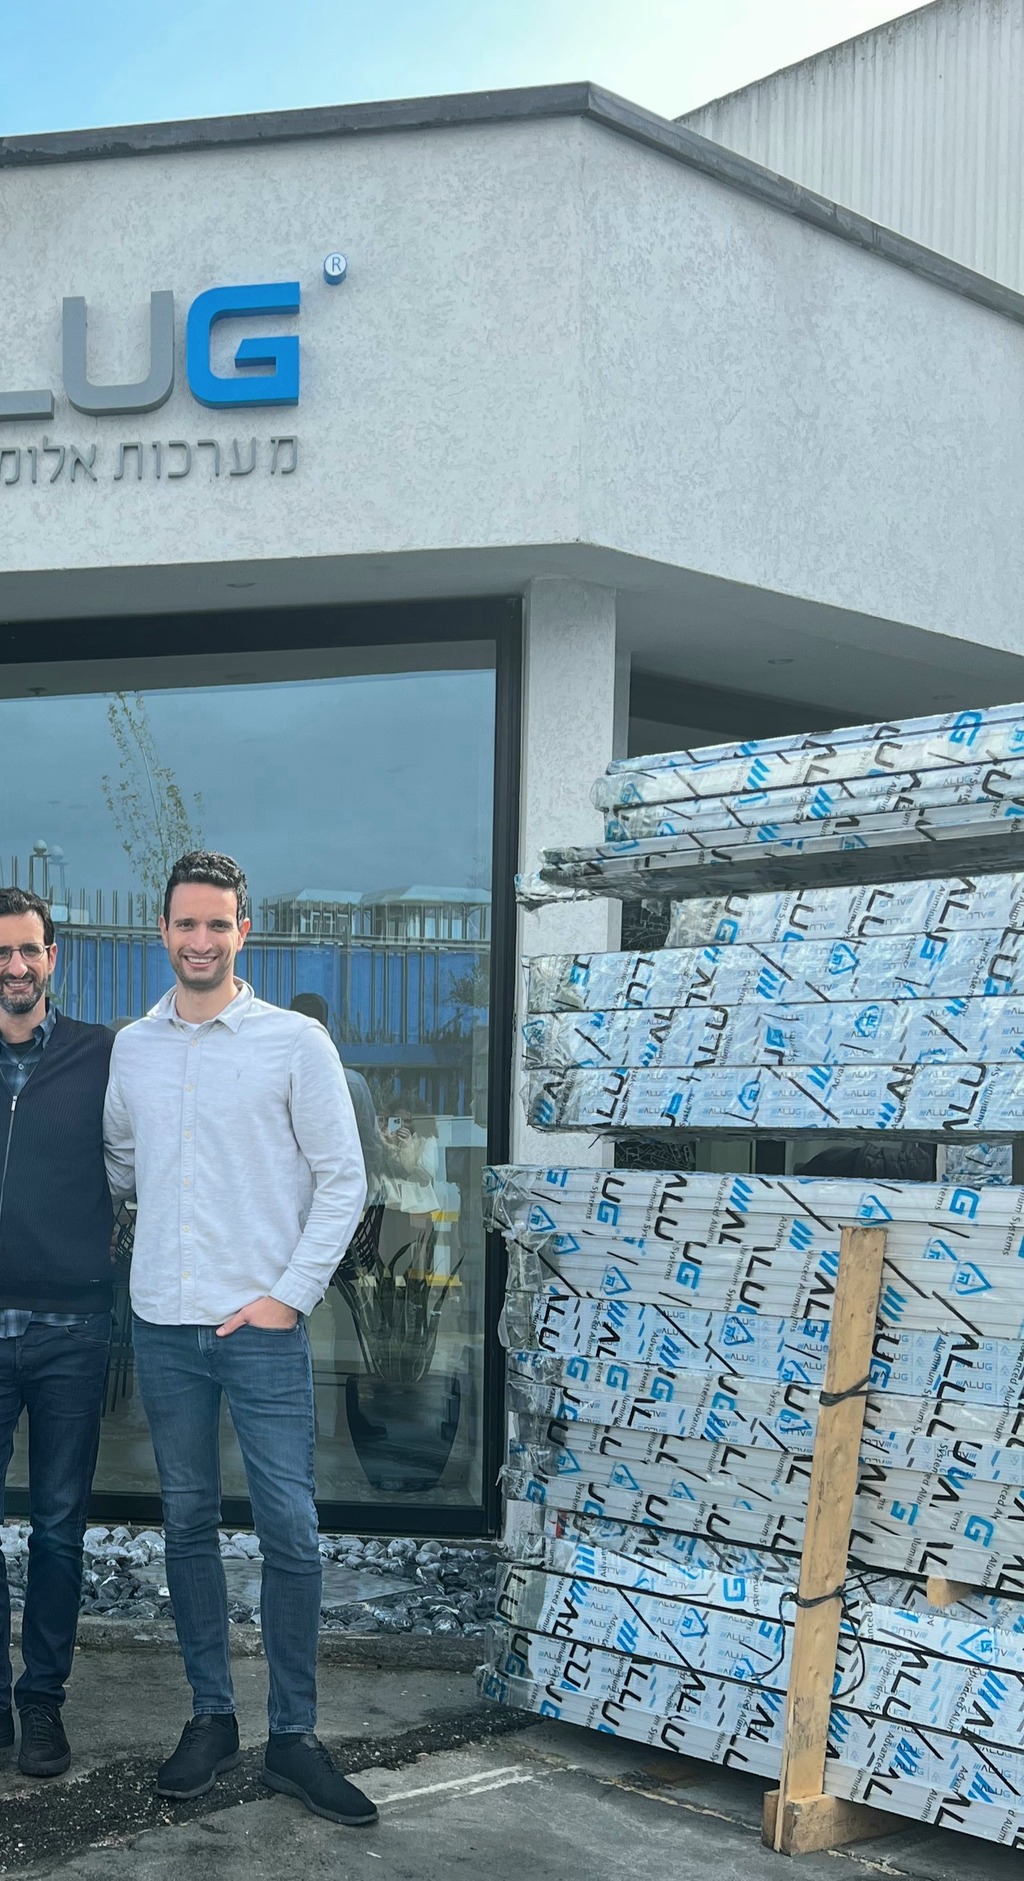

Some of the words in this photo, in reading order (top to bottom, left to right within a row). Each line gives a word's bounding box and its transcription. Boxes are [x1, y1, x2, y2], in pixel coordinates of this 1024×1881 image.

[113, 434, 299, 483] מערכות
[584, 1185, 599, 1221] Systems
[596, 1176, 626, 1227] UG
[1002, 1215, 1021, 1256] Systems
[676, 1240, 708, 1291] UG
[730, 1352, 756, 1362] ALUG
[962, 1381, 993, 1391] ALUG
